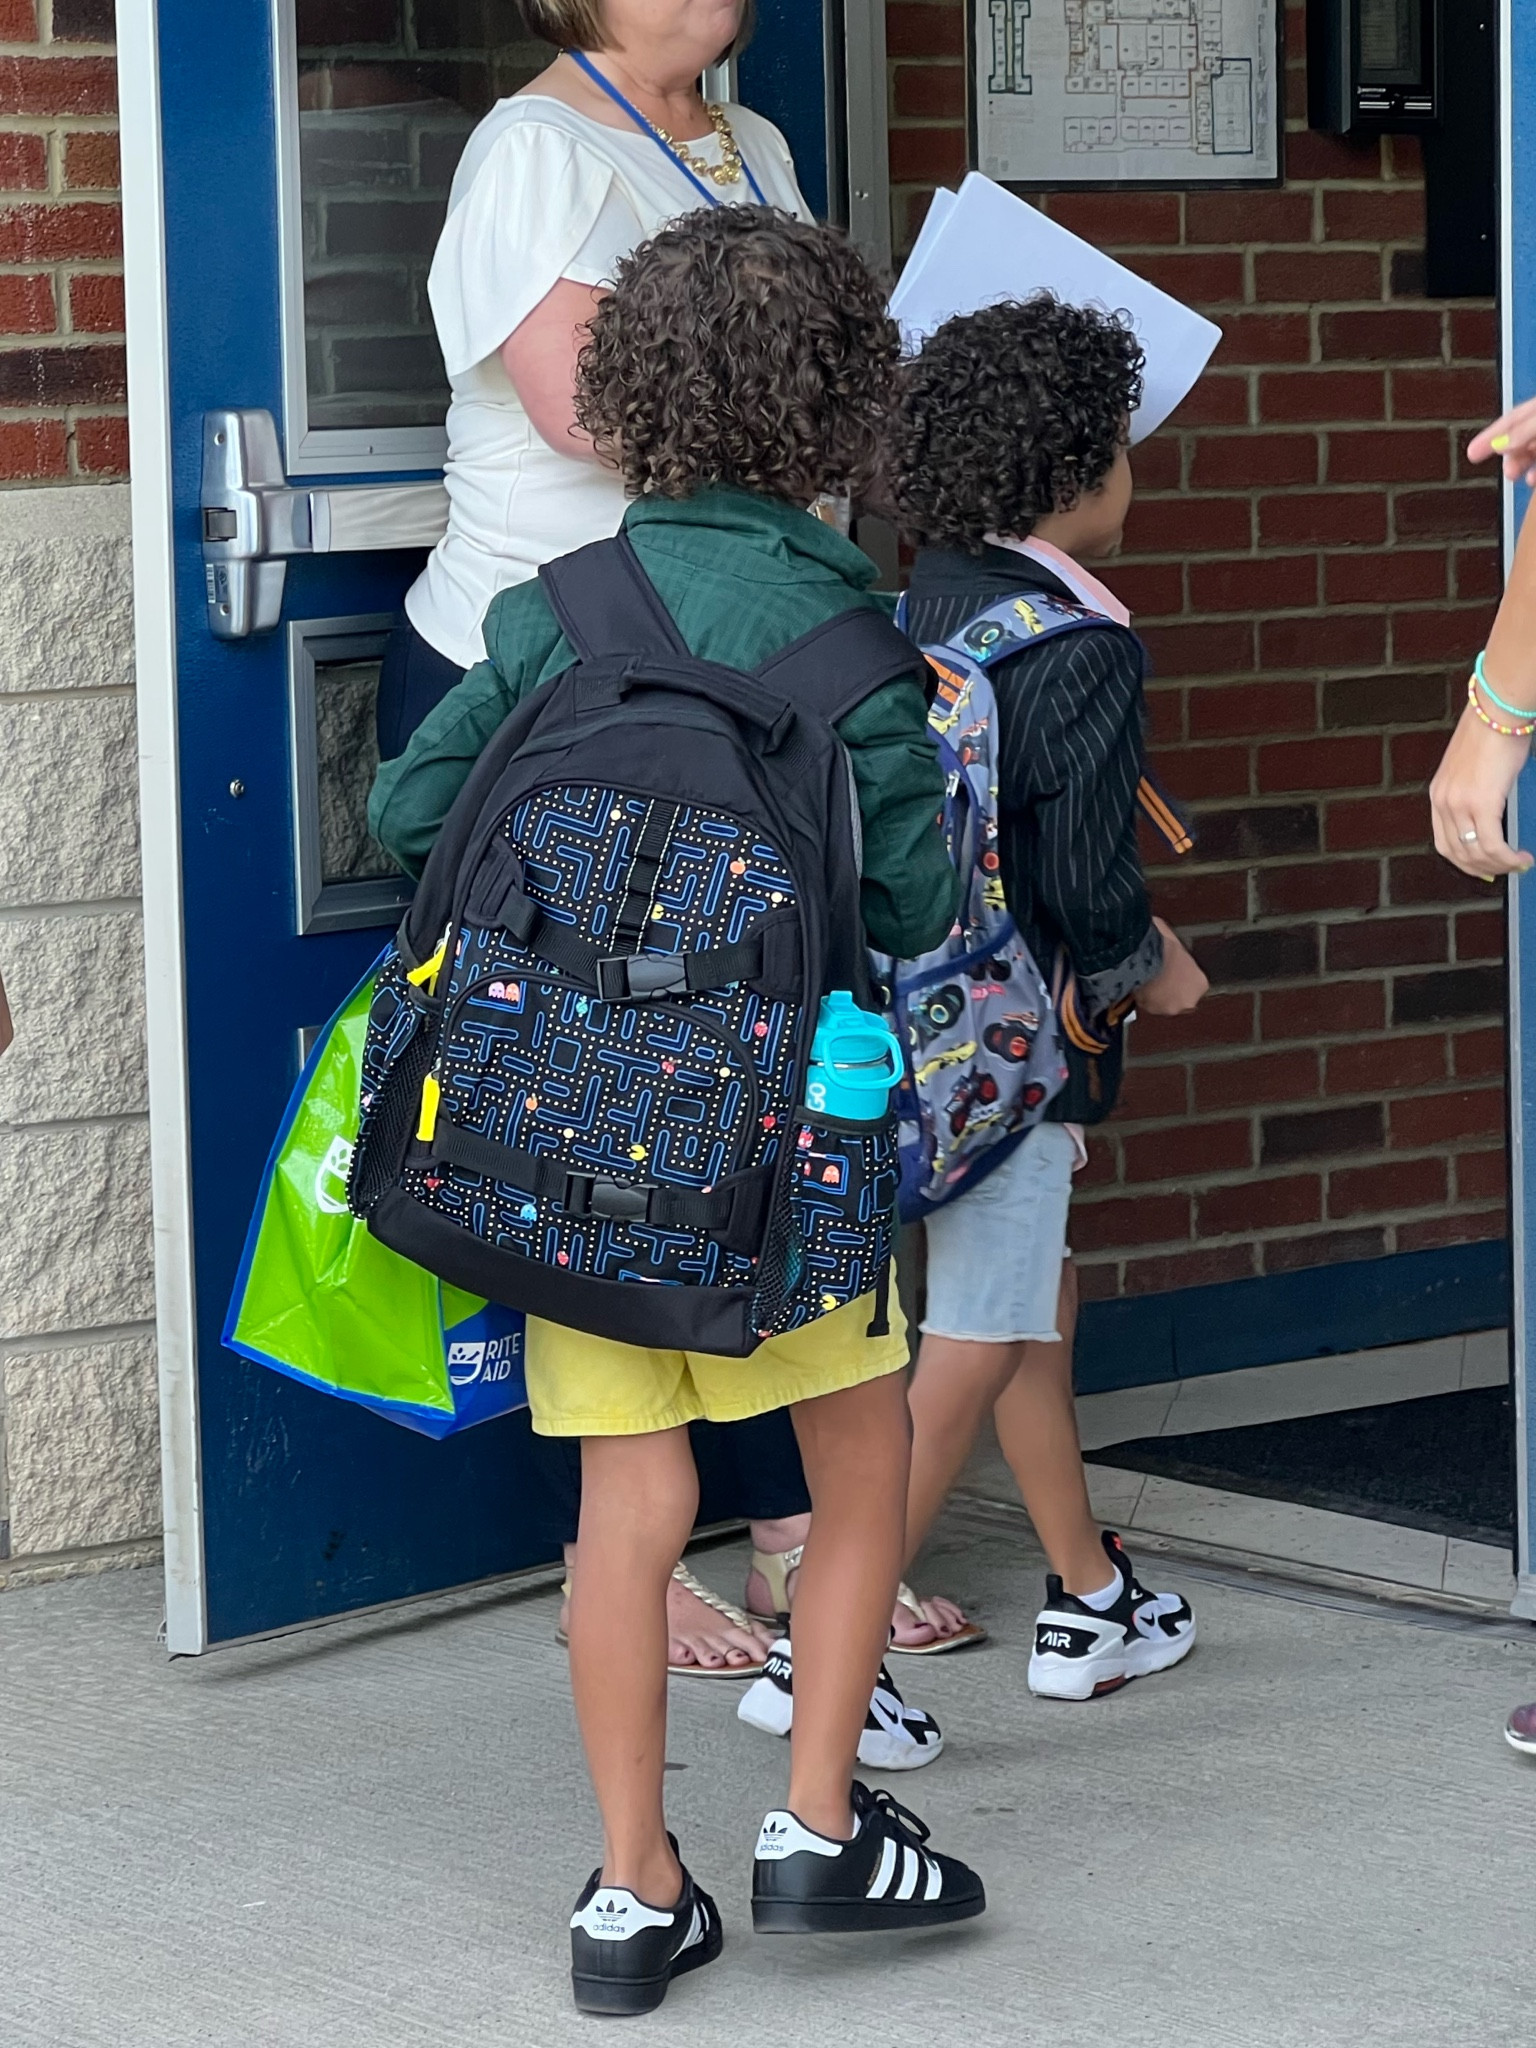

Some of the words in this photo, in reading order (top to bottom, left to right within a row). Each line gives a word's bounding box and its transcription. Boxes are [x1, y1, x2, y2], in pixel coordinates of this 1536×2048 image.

[485, 1332, 522, 1361] RITE
[480, 1360, 511, 1384] AID
[1040, 1630, 1072, 1649] AIR
[763, 1656, 793, 1680] AIR
[593, 1923, 626, 1934] adidas
